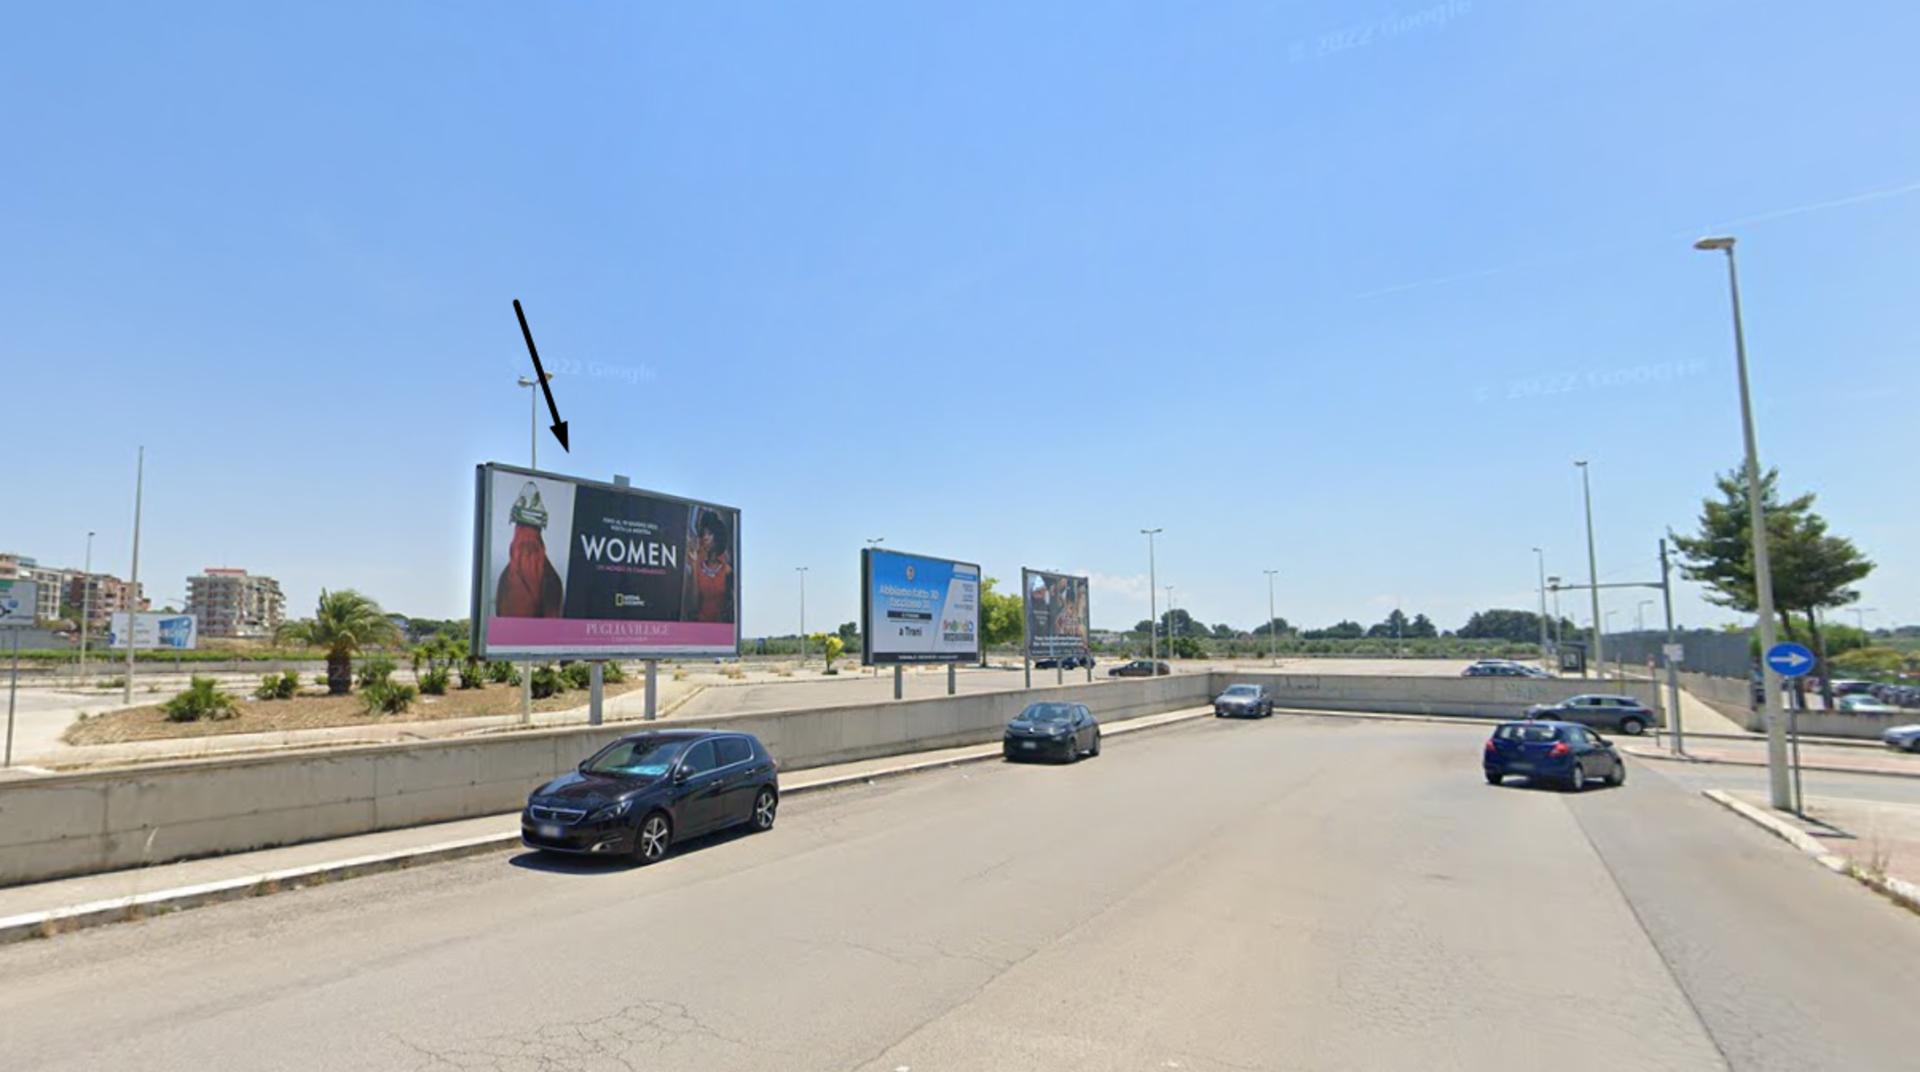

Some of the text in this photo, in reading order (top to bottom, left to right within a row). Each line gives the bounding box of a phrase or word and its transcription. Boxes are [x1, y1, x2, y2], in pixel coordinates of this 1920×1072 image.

[580, 534, 677, 568] WOMEN
[586, 623, 670, 635] PUGLIA VILLAGE
[904, 626, 922, 636] Trani
